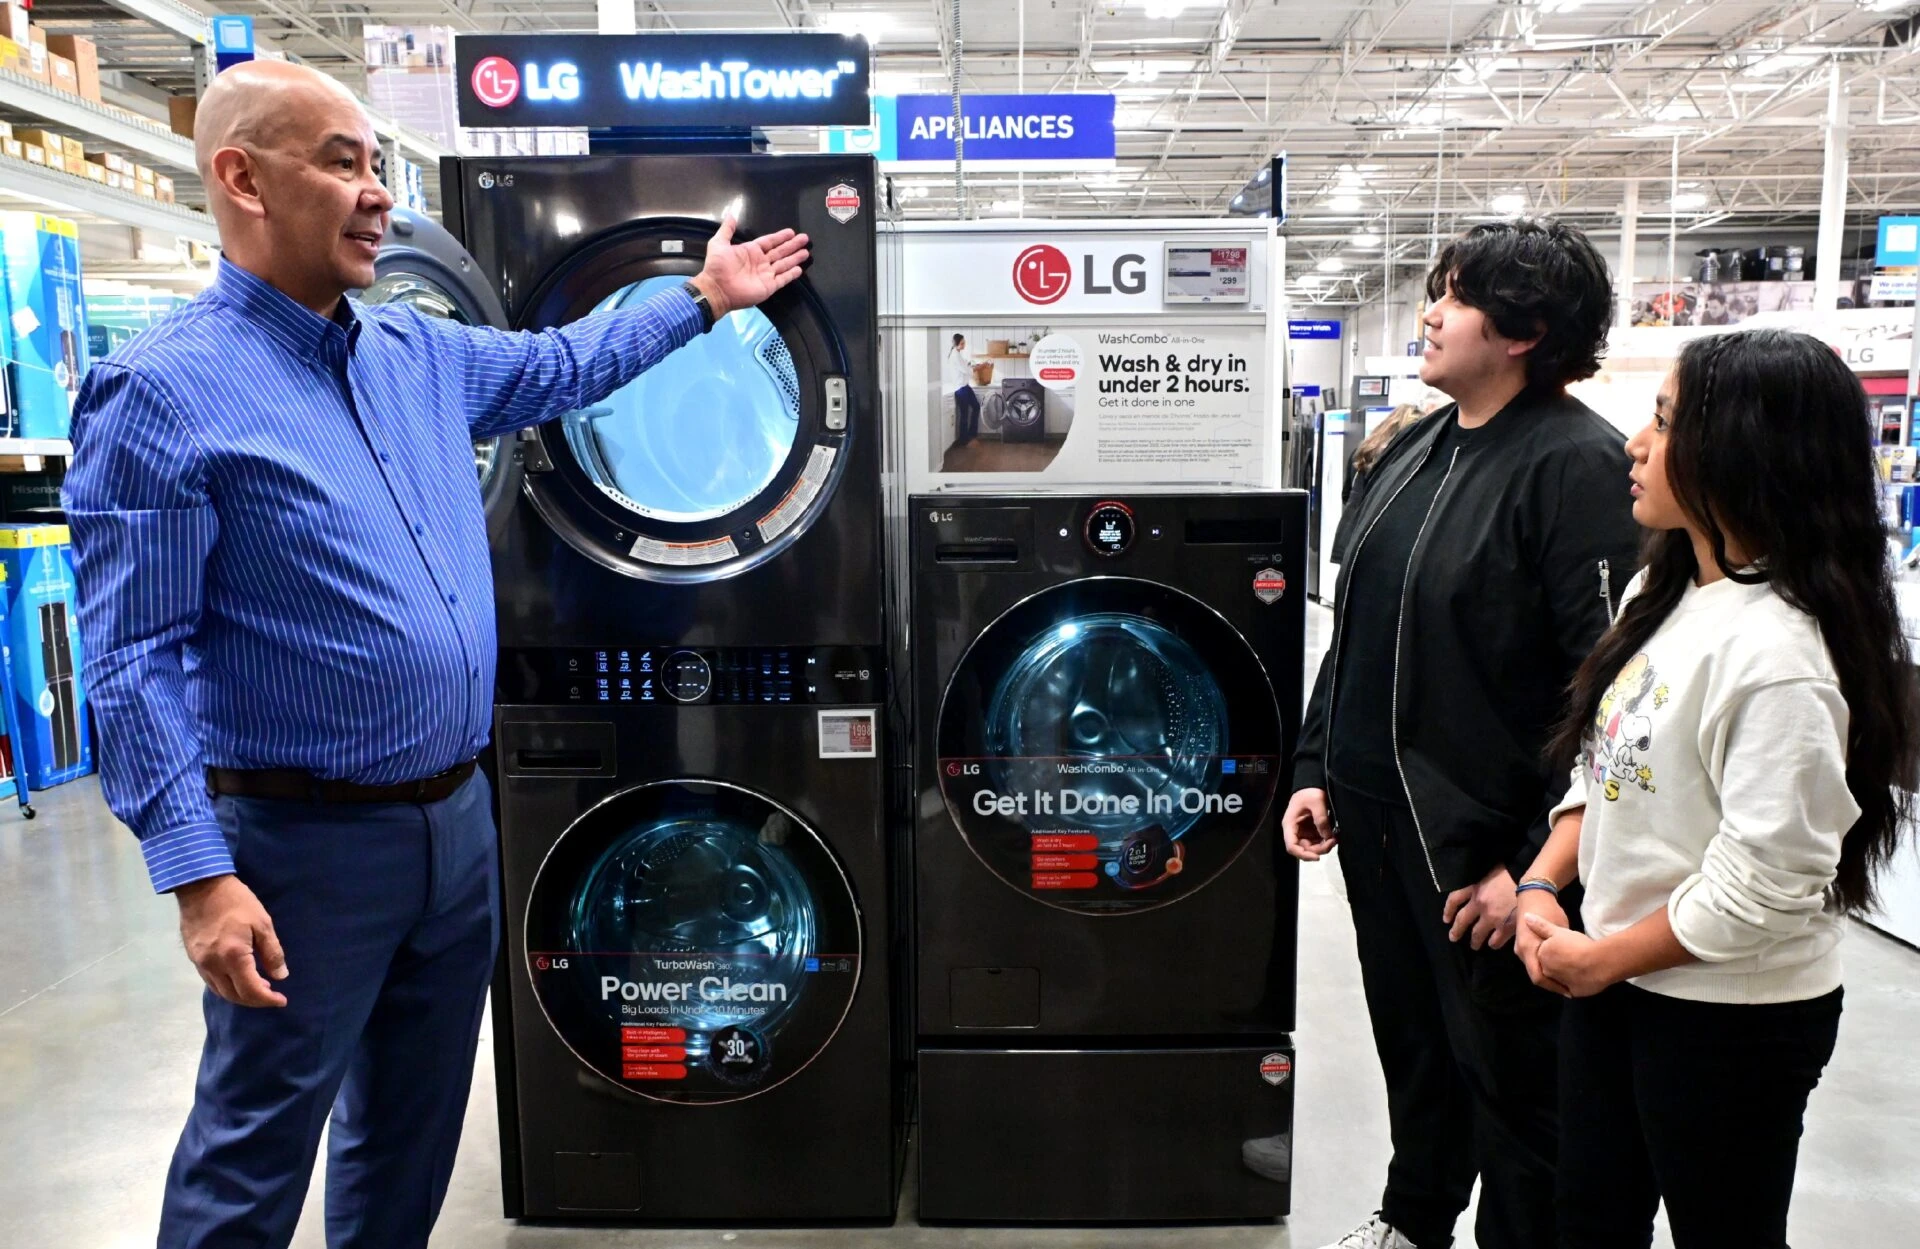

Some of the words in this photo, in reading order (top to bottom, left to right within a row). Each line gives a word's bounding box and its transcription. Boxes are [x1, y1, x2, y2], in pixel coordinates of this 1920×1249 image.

[525, 62, 580, 100] LG
[910, 115, 1074, 140] APPLIANCES
[496, 174, 514, 187] LG
[1083, 253, 1146, 295] LG
[1847, 347, 1874, 363] LG
[1099, 354, 1159, 372] Wash
[1166, 354, 1181, 372] &
[1187, 354, 1223, 375] dry
[1228, 353, 1246, 372] in
[1099, 375, 1160, 393] under
[1166, 375, 1179, 392] 2
[1098, 397, 1119, 407] Get
[1121, 397, 1128, 407] it
[1131, 397, 1160, 407] done
[1163, 397, 1171, 407] in
[1174, 399, 1195, 407] one
[12, 485, 62, 494] Hisense
[941, 513, 952, 521] LG
[964, 764, 980, 774] LG
[973, 789, 1028, 816] Get
[1035, 789, 1053, 815] It
[1060, 789, 1139, 815] Done
[1147, 788, 1172, 814] In
[1180, 788, 1242, 814] One
[553, 959, 568, 969] LG
[601, 976, 692, 1001] Power
[700, 976, 787, 1001] Clean
[622, 1005, 636, 1015] Big
[639, 1004, 669, 1014] Loads
[671, 1005, 678, 1014] In
[727, 1039, 745, 1057] 30
